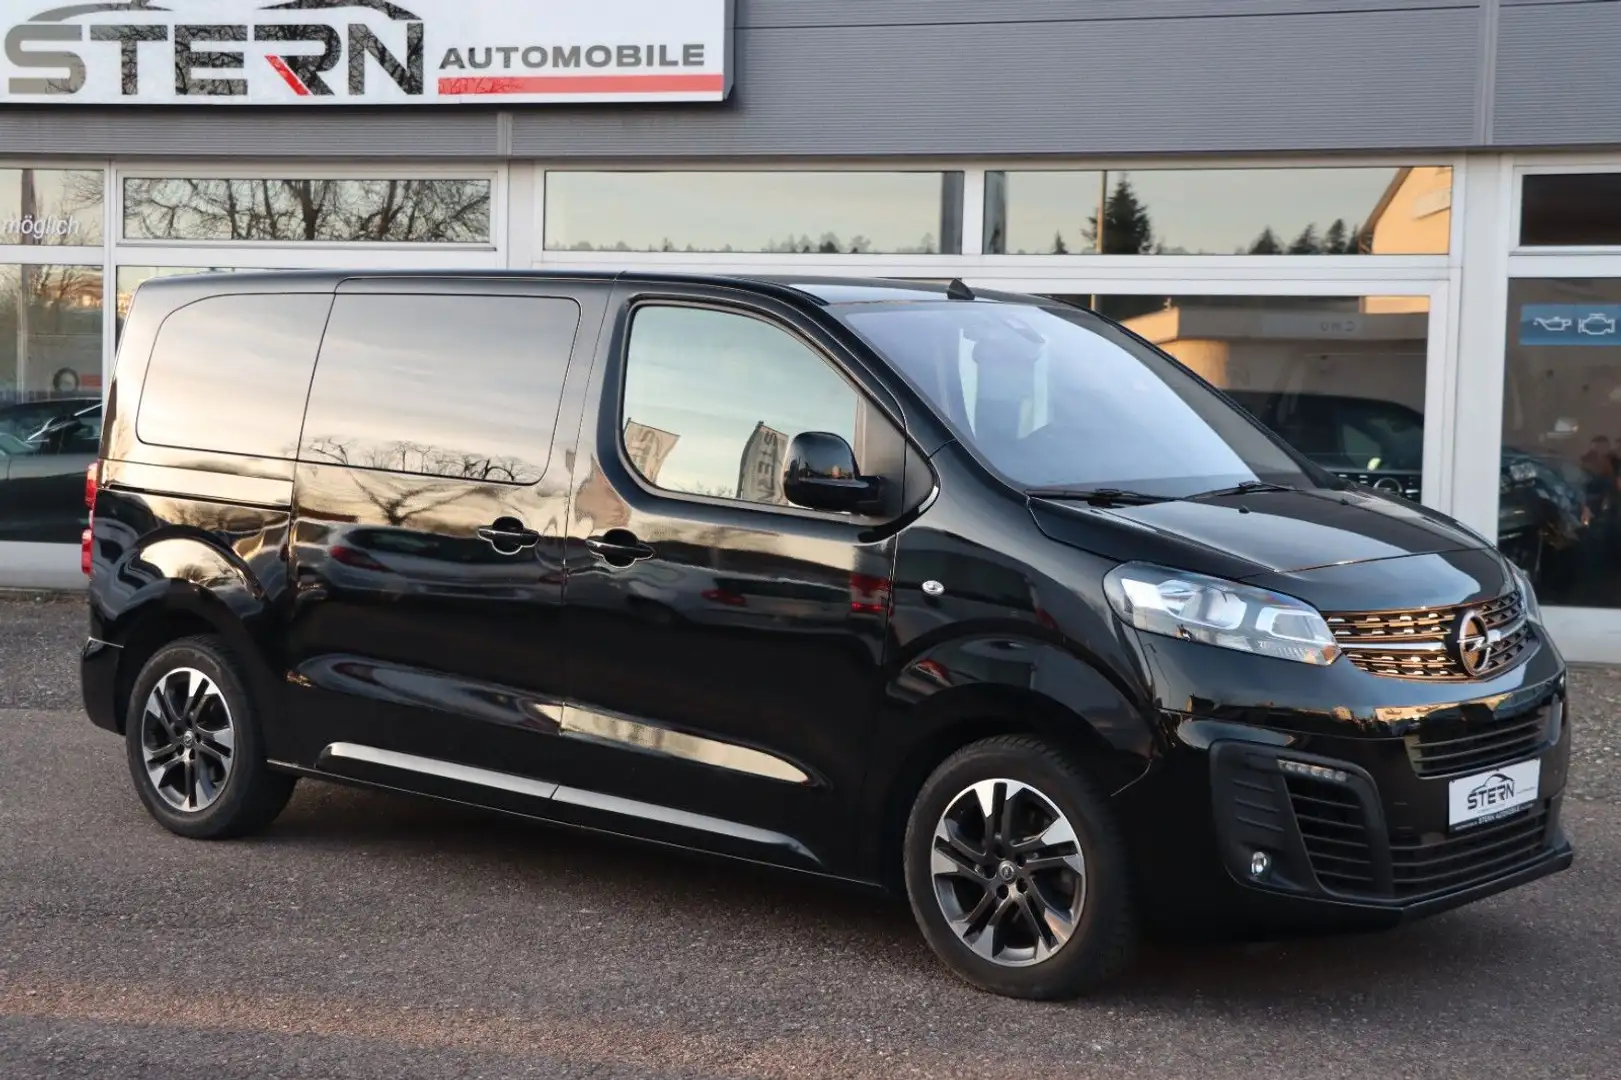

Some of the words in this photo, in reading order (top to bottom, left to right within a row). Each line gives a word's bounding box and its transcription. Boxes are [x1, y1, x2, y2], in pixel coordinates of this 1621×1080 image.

[4, 23, 424, 96] STERN
[439, 43, 704, 69] AUTOMOBILE
[6, 214, 80, 239] möglich
[1467, 783, 1515, 810] STERN
